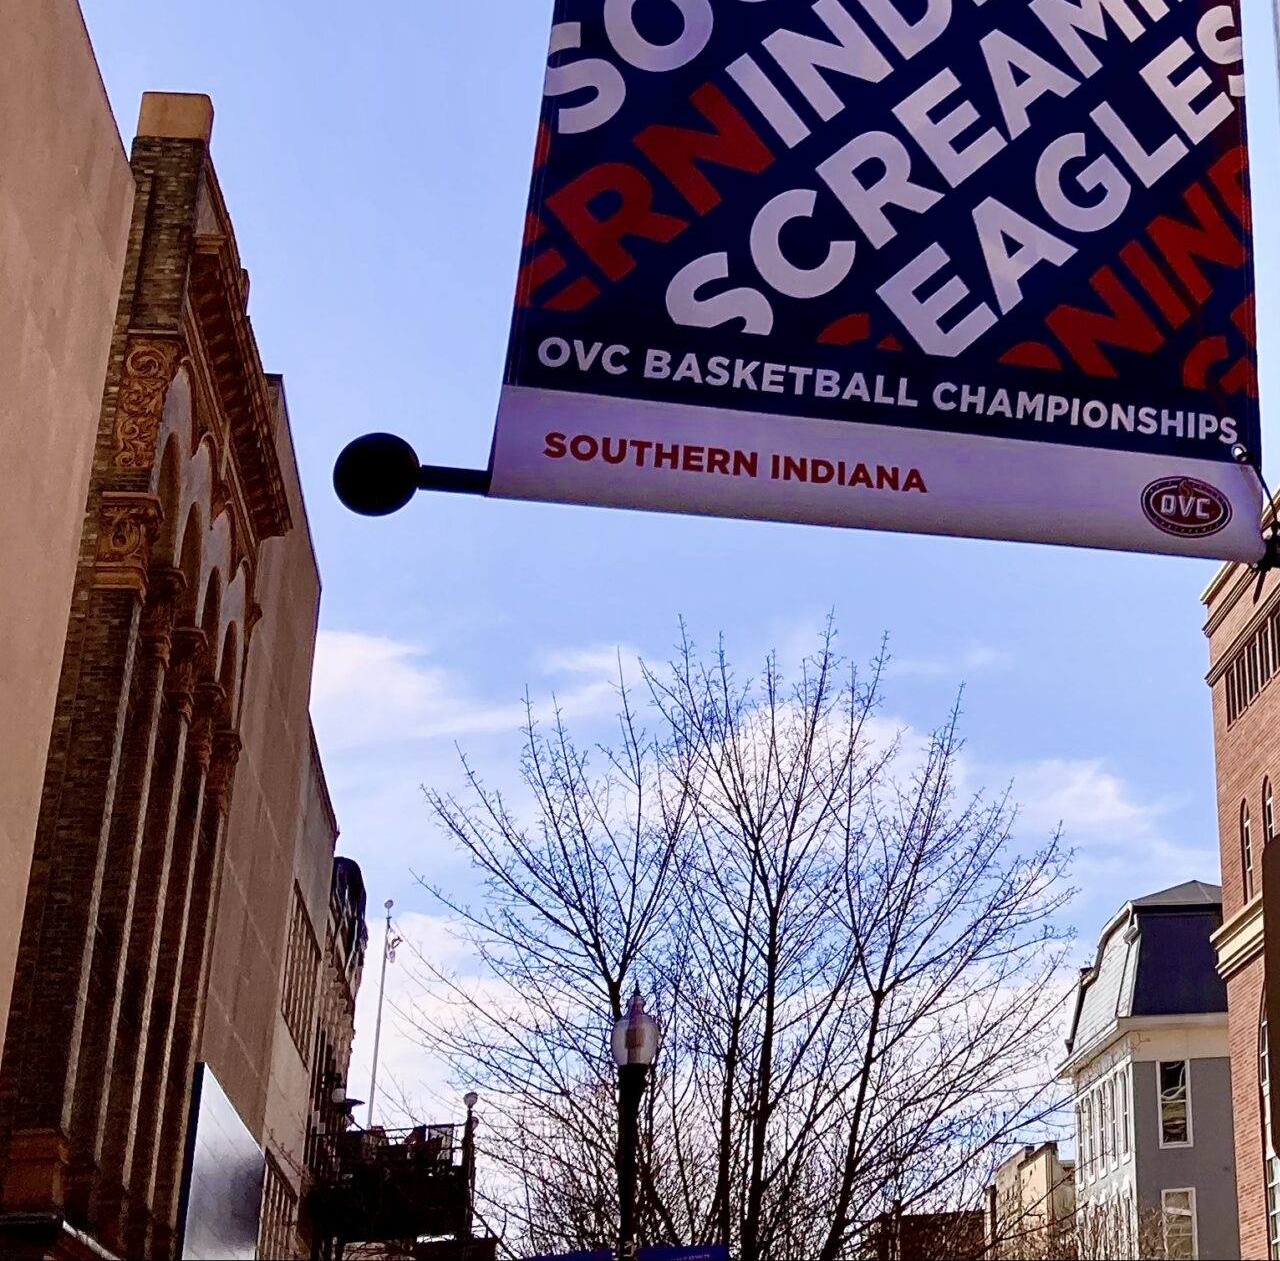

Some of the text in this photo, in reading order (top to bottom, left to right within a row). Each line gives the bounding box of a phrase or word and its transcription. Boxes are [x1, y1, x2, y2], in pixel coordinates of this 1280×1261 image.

[538, 337, 1242, 445] OVC BASKETBALL CHAMPIONSHIPS
[543, 431, 928, 494] SOUTHERN INDIANA
[1160, 494, 1211, 519] OVC
